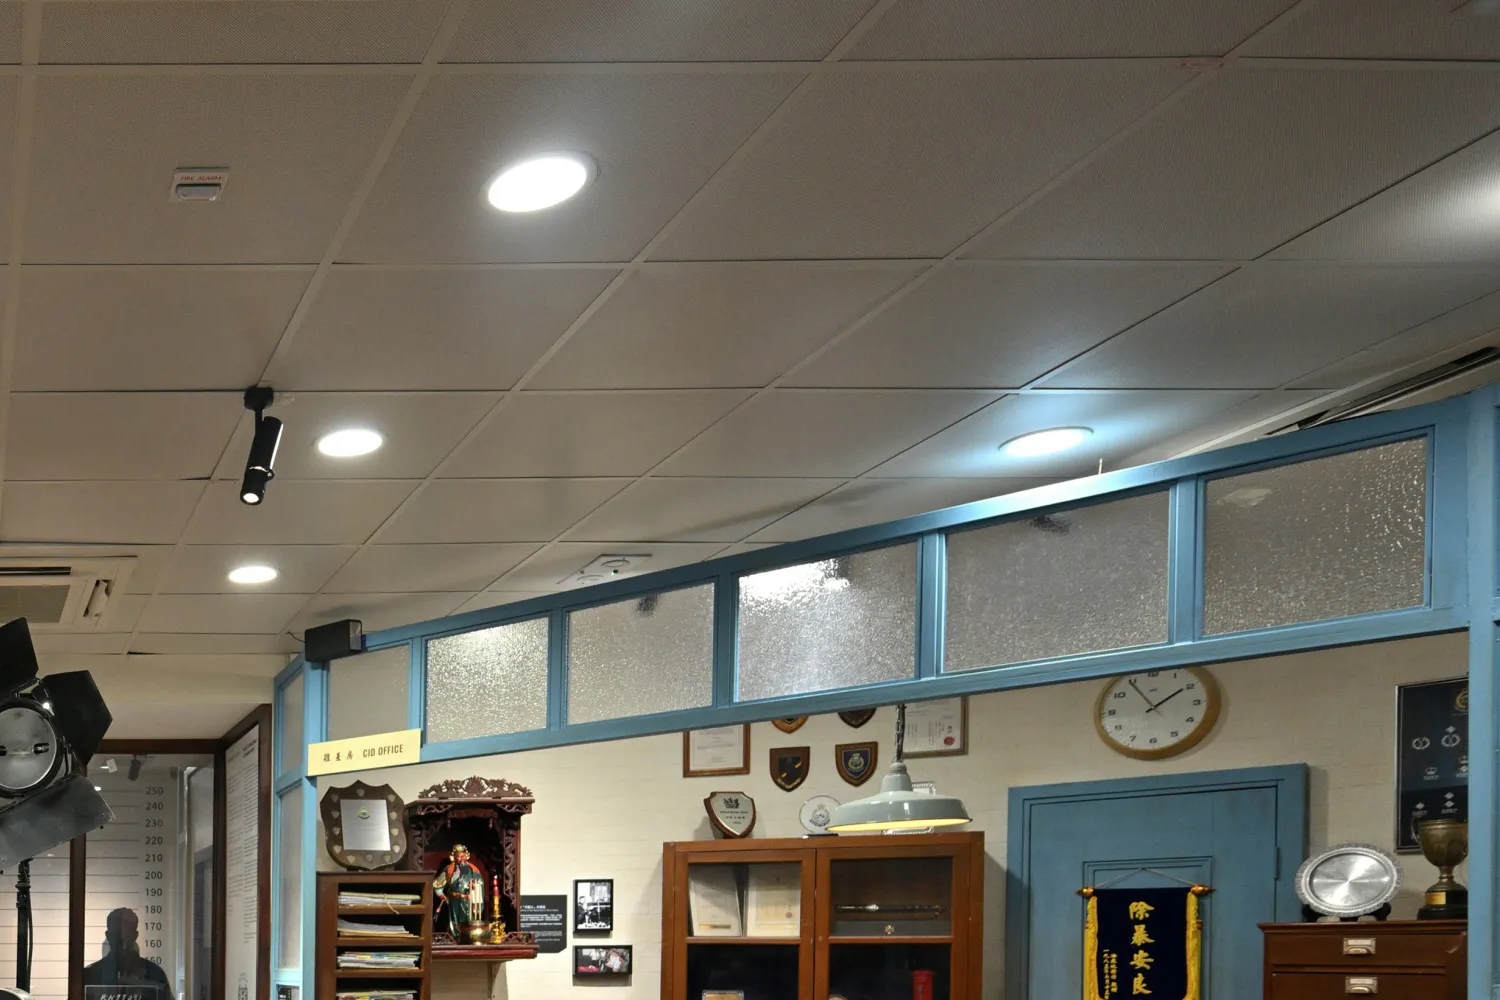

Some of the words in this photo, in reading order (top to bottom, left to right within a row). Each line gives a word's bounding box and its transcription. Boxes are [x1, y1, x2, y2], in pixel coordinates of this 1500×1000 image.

[362, 748, 376, 758] CID
[378, 744, 403, 756] OFFICE
[145, 786, 163, 795] 250
[145, 802, 163, 811] 240
[145, 819, 163, 828] 230
[145, 836, 163, 845] 220
[145, 854, 163, 862] 210
[145, 871, 163, 880] 200
[145, 888, 163, 897] 190
[145, 905, 162, 914] 180
[145, 922, 162, 931] 170
[145, 939, 162, 948] 160
[1129, 901, 1155, 995] 除暴安良
